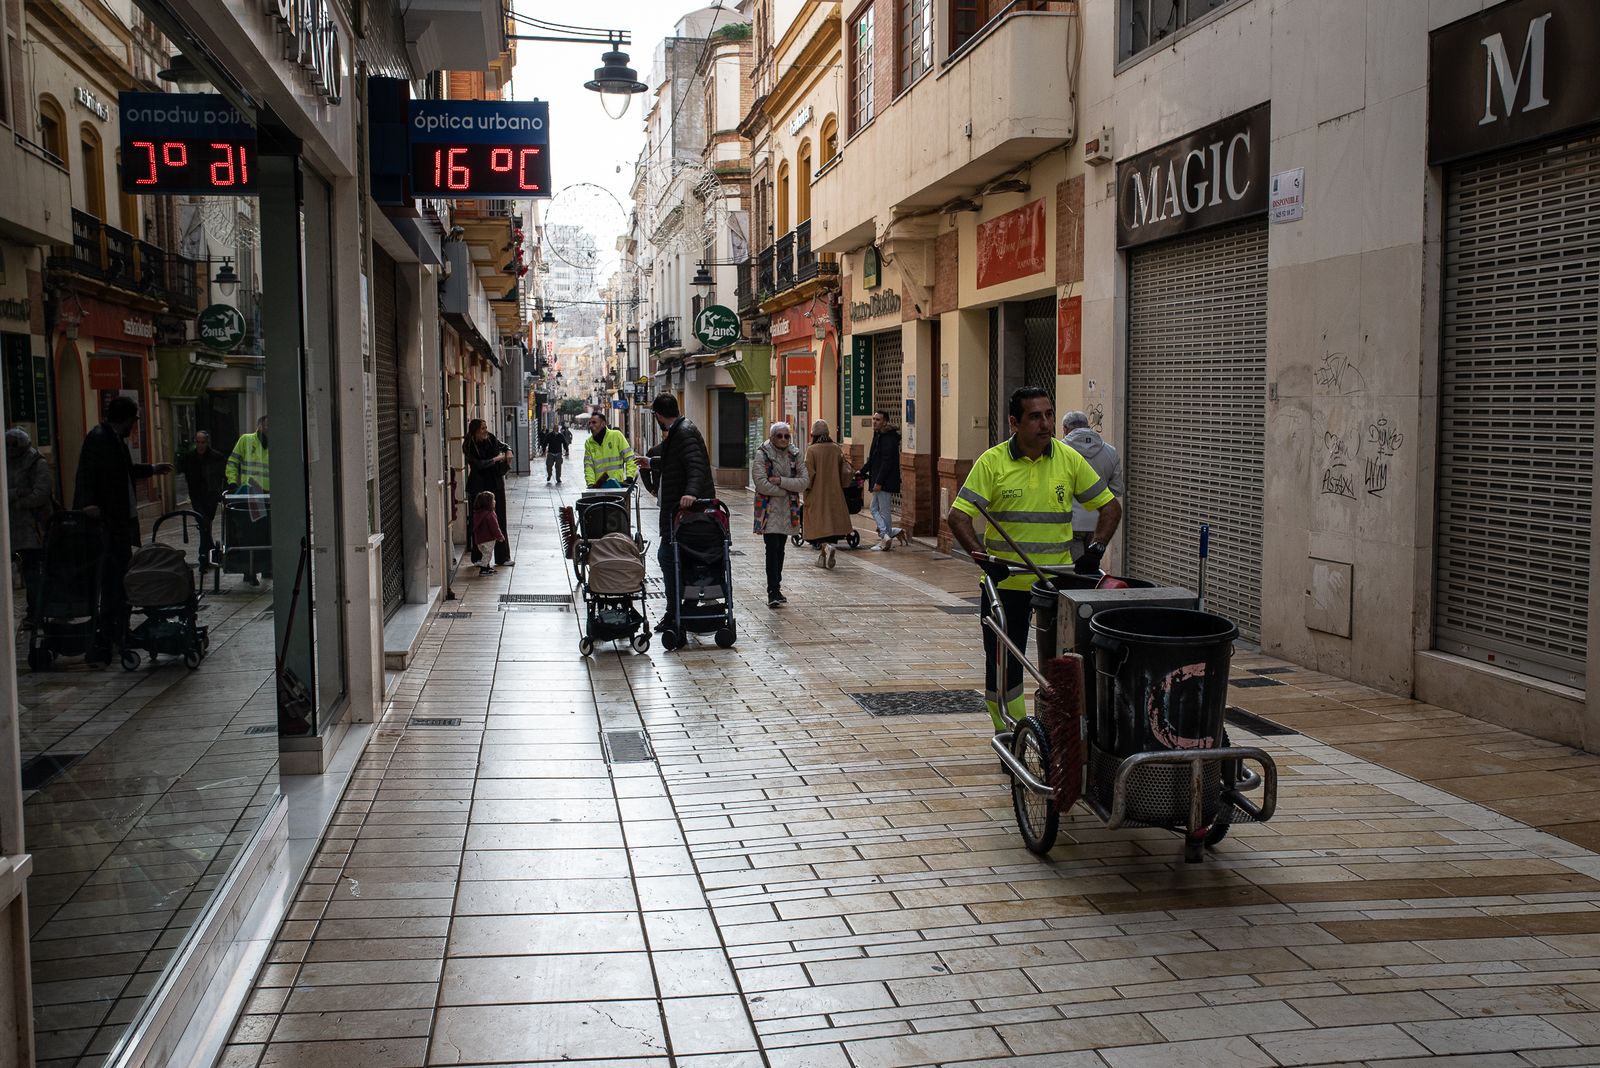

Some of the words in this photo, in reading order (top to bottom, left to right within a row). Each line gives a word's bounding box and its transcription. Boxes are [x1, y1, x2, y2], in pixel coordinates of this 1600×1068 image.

[1478, 12, 1552, 125] M
[414, 110, 473, 132] óptica
[478, 112, 543, 129] urbano
[435, 148, 470, 189] 16
[1131, 131, 1250, 229] MAGIC
